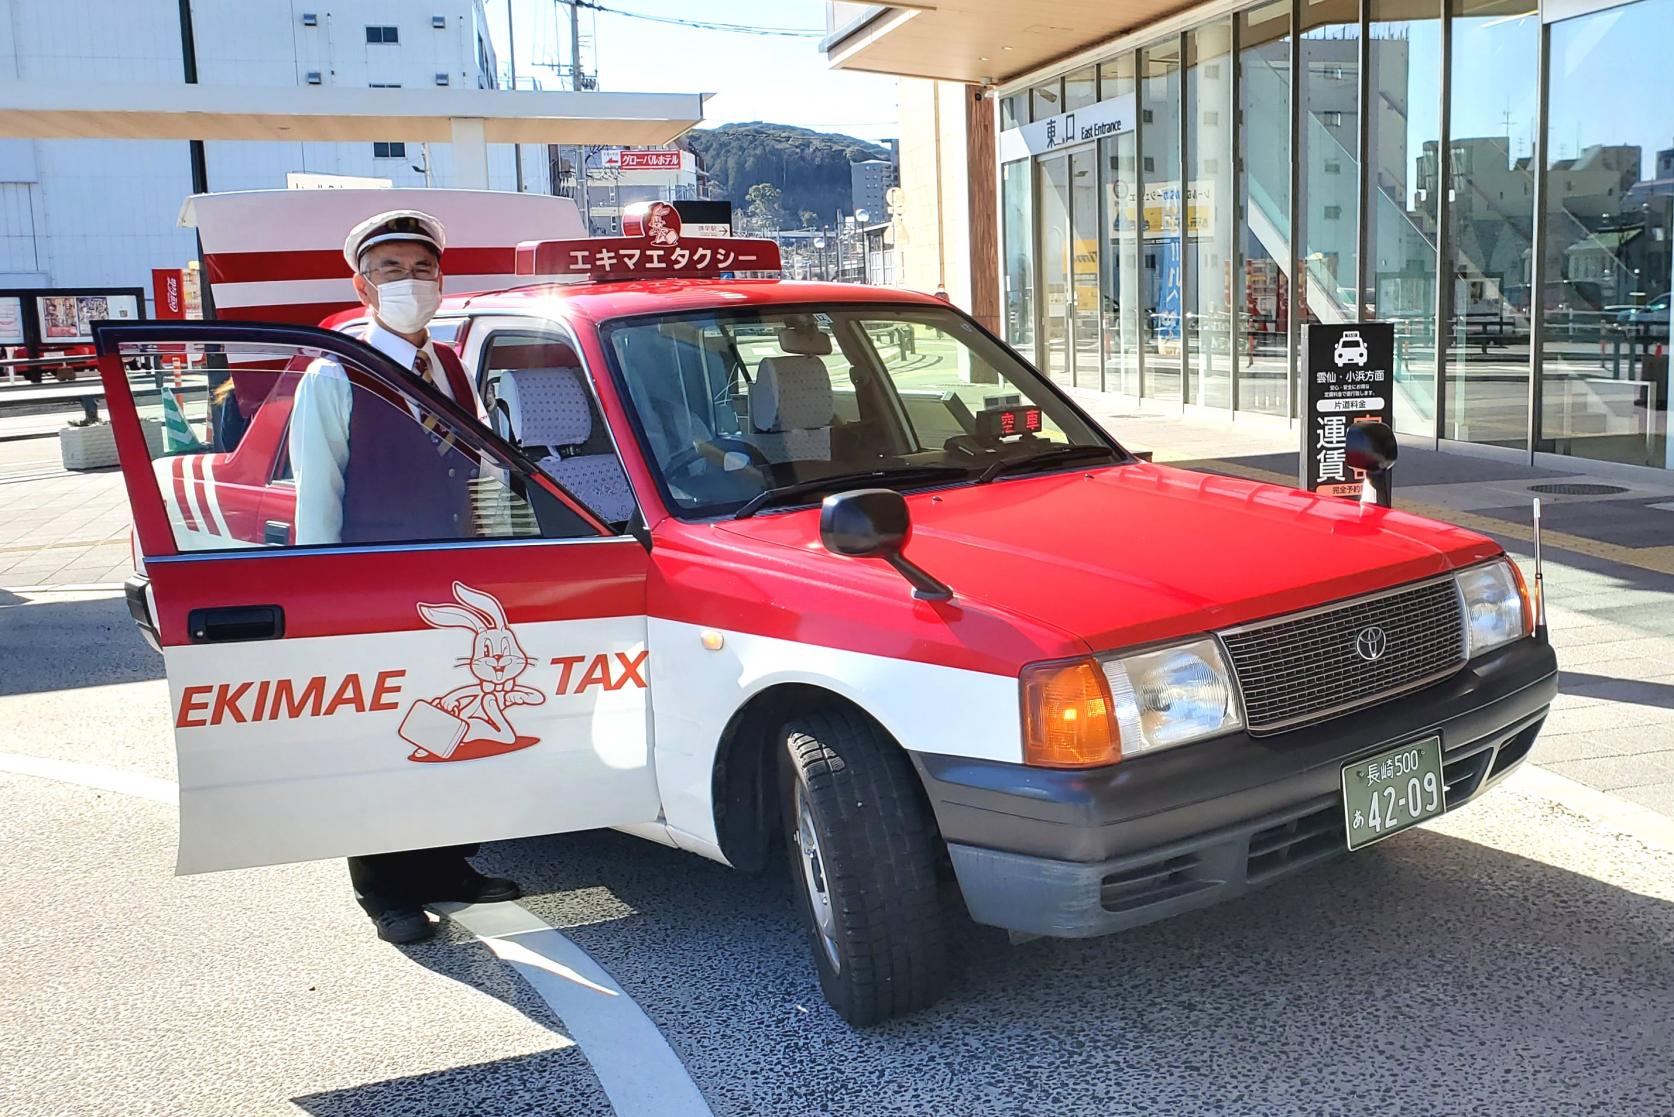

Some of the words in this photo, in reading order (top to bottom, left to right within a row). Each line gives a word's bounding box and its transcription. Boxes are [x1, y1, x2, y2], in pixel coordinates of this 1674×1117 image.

[1046, 113, 1075, 149] 東口
[1081, 125, 1093, 141] East
[1093, 119, 1122, 137] Entrance
[622, 154, 679, 166] グローバルホテル
[569, 247, 757, 272] エキマエタクシー
[1316, 370, 1385, 383] 雲仙・小浜方面
[1334, 400, 1366, 410] 片道料金
[1001, 409, 1040, 435] 空車
[1316, 416, 1346, 482] 運賃
[1332, 485, 1363, 495] 完全予約
[549, 650, 649, 696] TAX
[175, 669, 407, 728] EKIMAE
[1352, 809, 1364, 829] あ
[1368, 772, 1438, 833] 42-09
